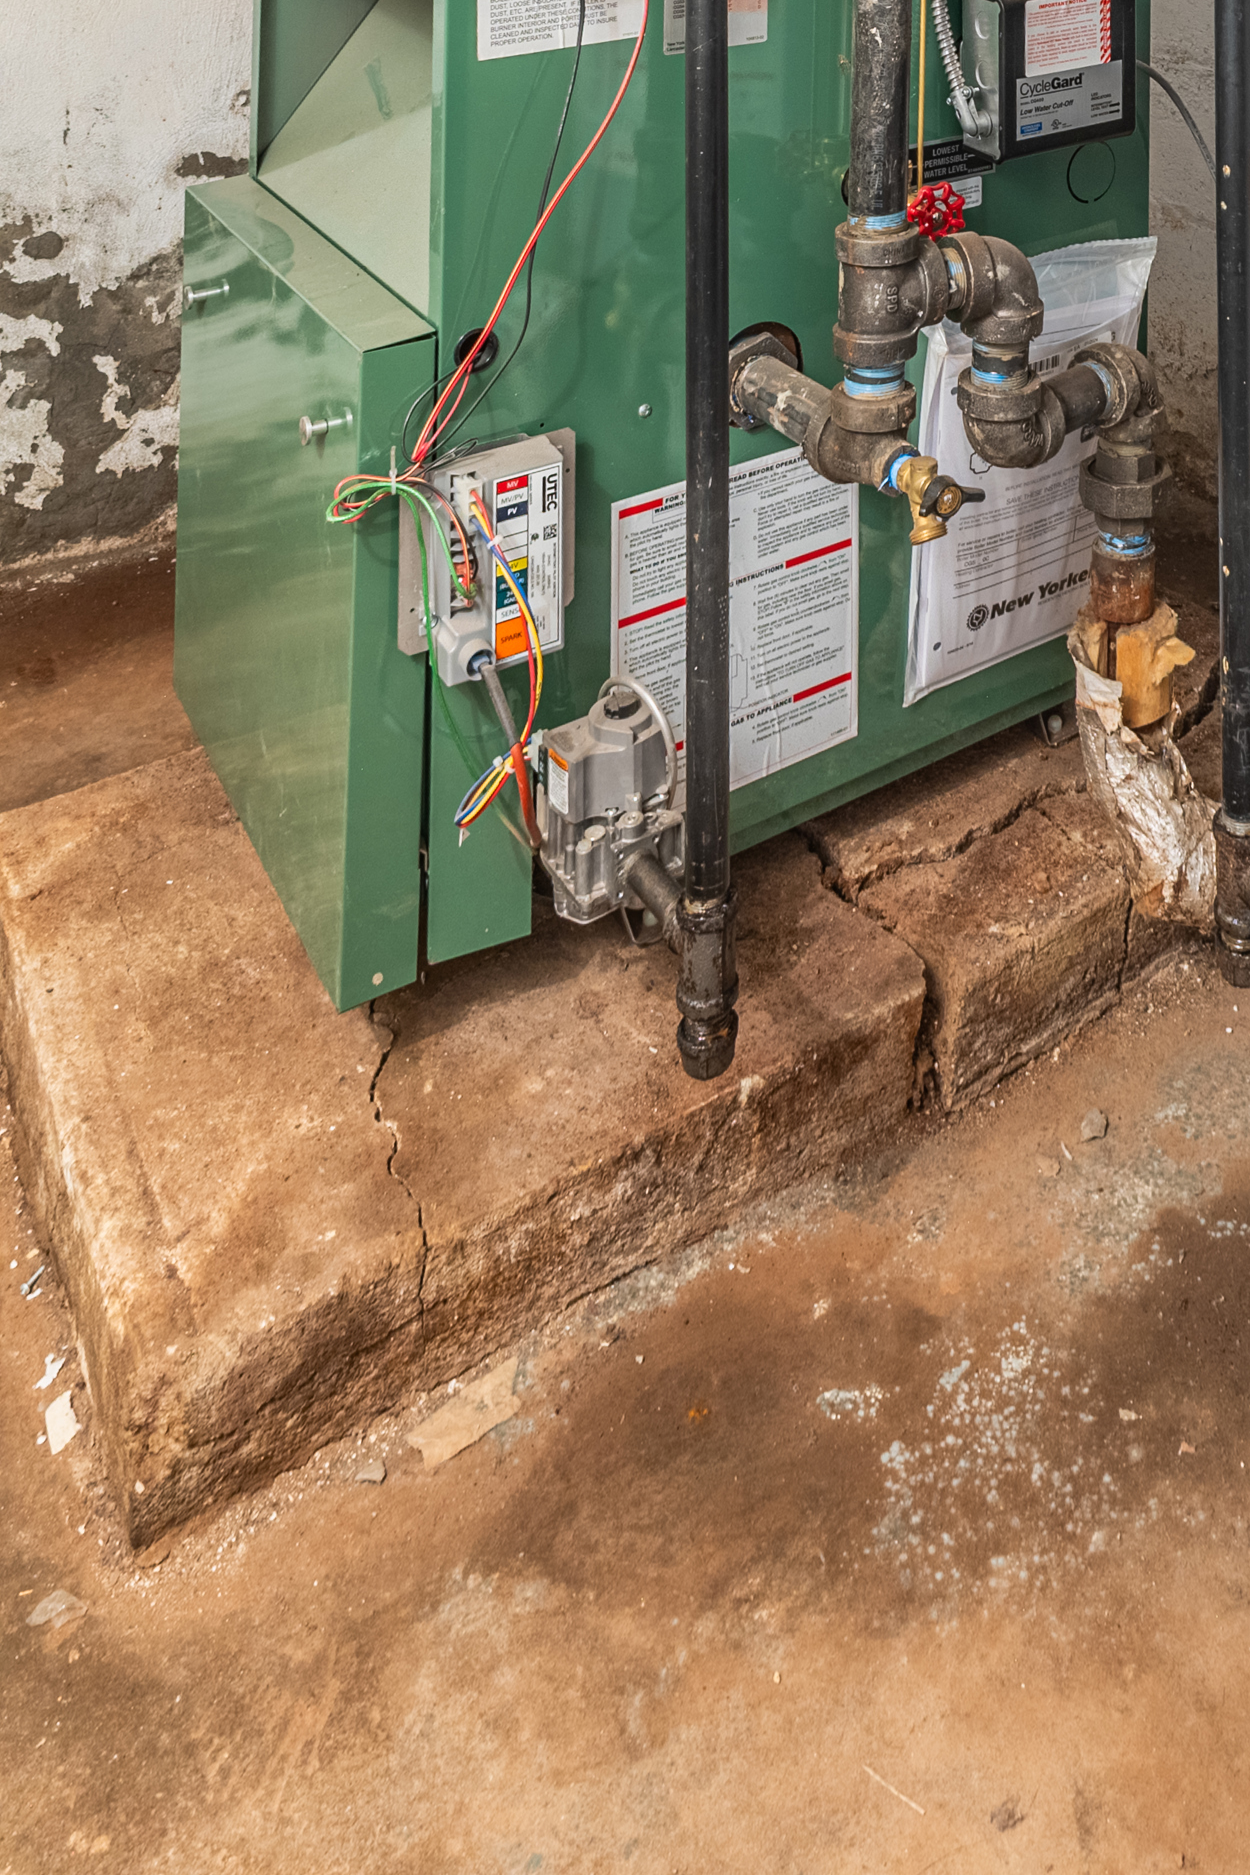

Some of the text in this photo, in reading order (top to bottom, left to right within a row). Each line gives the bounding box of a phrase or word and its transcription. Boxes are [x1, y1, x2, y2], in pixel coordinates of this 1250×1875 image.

[1039, 0, 1067, 9] IMPORTANT
[491, 33, 553, 47] PROPER OPERATION.
[1053, 100, 1074, 109] Cut-Off
[933, 145, 959, 157] LOWEST
[925, 153, 968, 168] PERMISSIBLE
[924, 164, 968, 178] WATER LEVEL
[887, 286, 898, 313] SPD
[748, 465, 774, 477] BEFORE
[501, 493, 523, 504] MV/PV
[547, 473, 557, 511] UTEC
[1006, 495, 1022, 505] SAVE
[1024, 491, 1042, 500] THESE
[665, 496, 681, 504] FOR
[736, 564, 784, 585] INSTRUCTIONS
[990, 570, 1091, 620] New Yorke
[501, 632, 522, 643] SPARK
[731, 718, 744, 727] GAS
[757, 697, 792, 716] APPLIANCE
